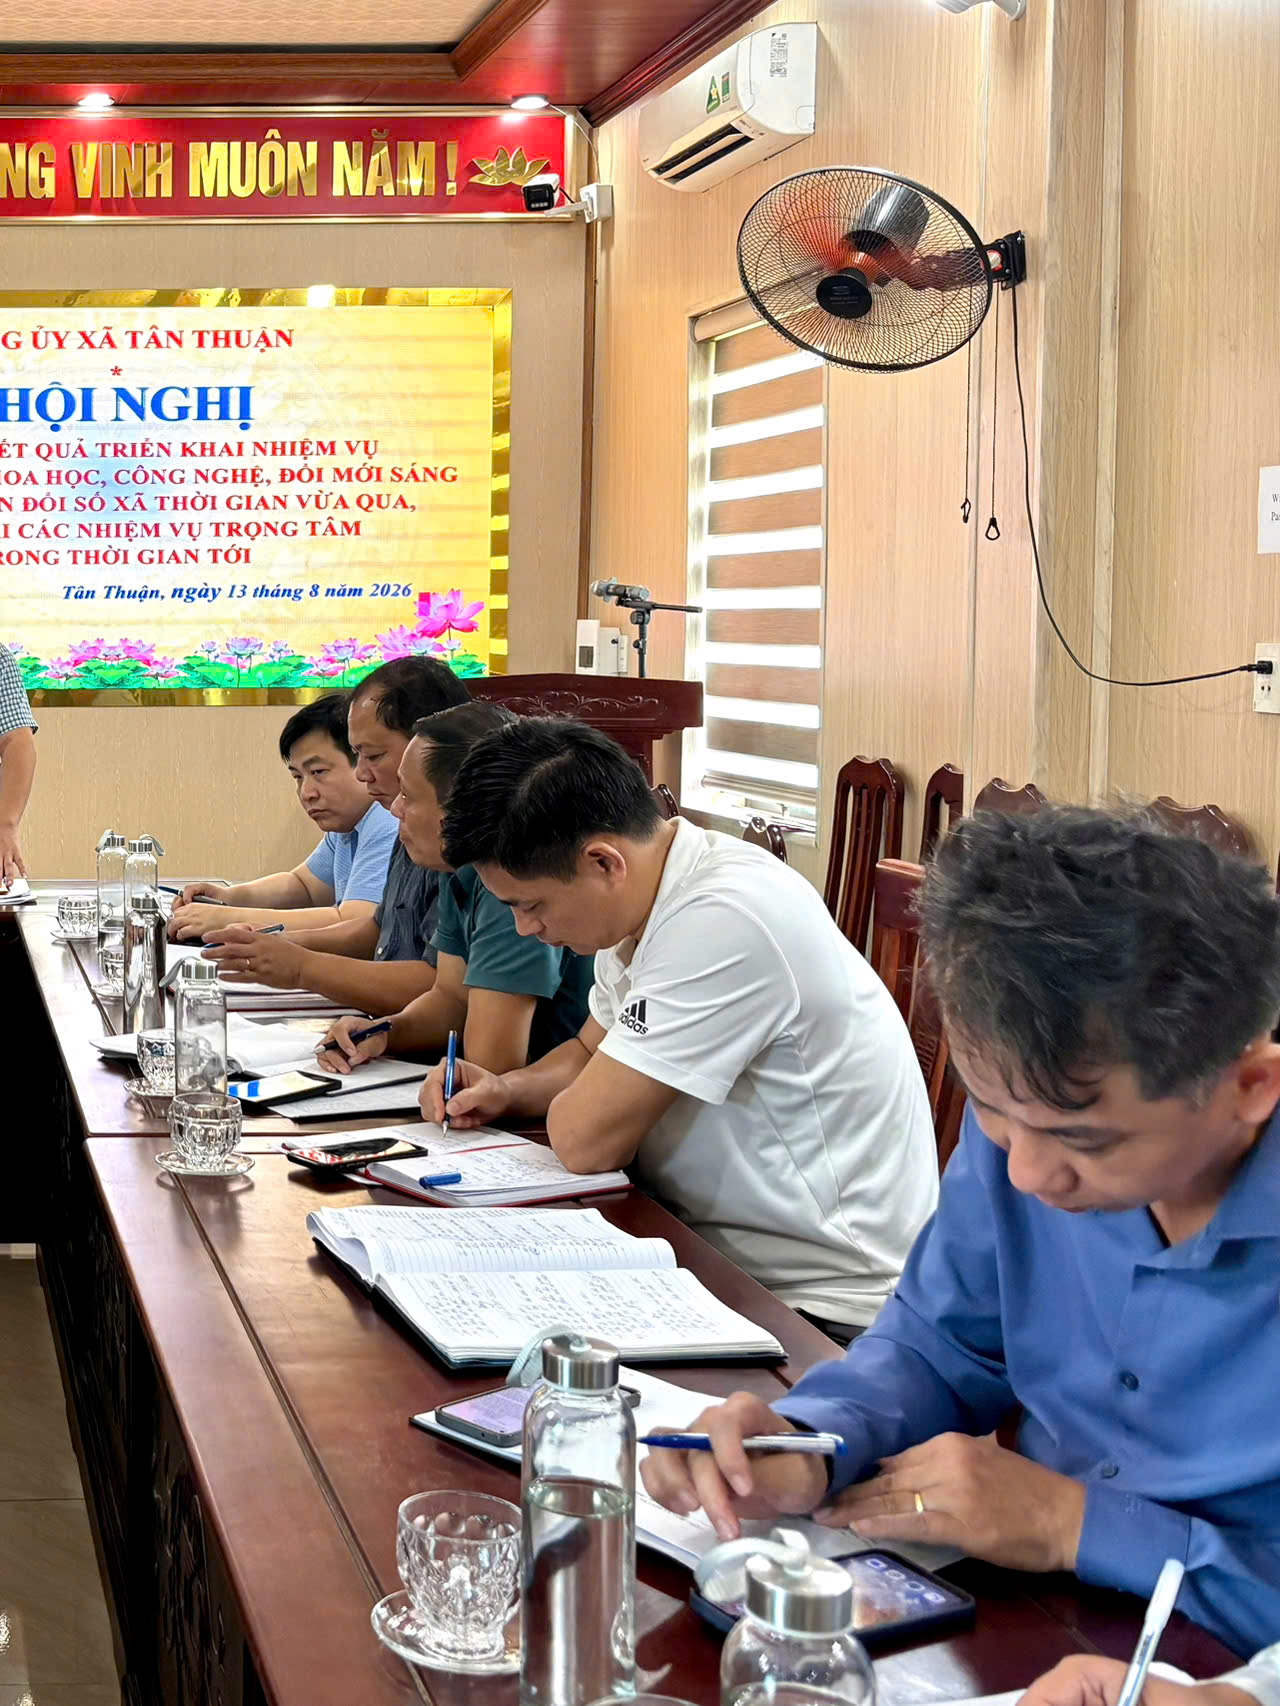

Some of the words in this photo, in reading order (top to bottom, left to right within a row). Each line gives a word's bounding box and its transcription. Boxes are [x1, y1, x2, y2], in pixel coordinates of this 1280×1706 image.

[72, 142, 173, 199] VINH
[188, 128, 318, 199] MUÔN
[332, 130, 458, 198] NĂM!
[31, 325, 71, 349] ỦY
[77, 326, 118, 349] XÃ
[124, 324, 185, 349] TÂN
[191, 326, 294, 352] THUẬN
[110, 385, 254, 430] NGHỊ
[35, 438, 89, 462] QUẢ
[95, 437, 173, 457] TRIỂN
[180, 441, 244, 457] KHAI
[252, 437, 337, 460] NHIỆM
[343, 439, 379, 459] VỤ
[46, 469, 108, 489] HỌC,
[113, 464, 186, 485] CÔNG
[194, 465, 272, 487] NGHỆ,
[279, 463, 324, 483] ĐỔI
[332, 462, 383, 482] MỚI
[389, 462, 458, 482] SÁNG
[22, 491, 67, 512] ĐỔI
[73, 491, 107, 512] SỐ
[112, 491, 148, 511] XÃ
[153, 490, 217, 511] THỜI
[225, 494, 289, 510] GIAN
[295, 489, 350, 509] VỪA
[355, 493, 417, 512] QUA,
[17, 518, 70, 538] CÁC
[76, 520, 161, 542] NHIỆM
[168, 522, 203, 541] VỤ
[209, 520, 299, 541] TRỌNG
[305, 515, 362, 536] TÂM
[66, 544, 129, 564] THỜI
[137, 548, 200, 564] GIAN
[206, 543, 251, 564] TỚI
[63, 585, 96, 599] Tân
[103, 584, 165, 602] Thuận,
[170, 582, 222, 603] ngày
[228, 584, 248, 598] 13
[252, 583, 304, 601] tháng
[308, 583, 320, 597] 8
[324, 583, 364, 597] năm
[369, 583, 412, 597] 2026
